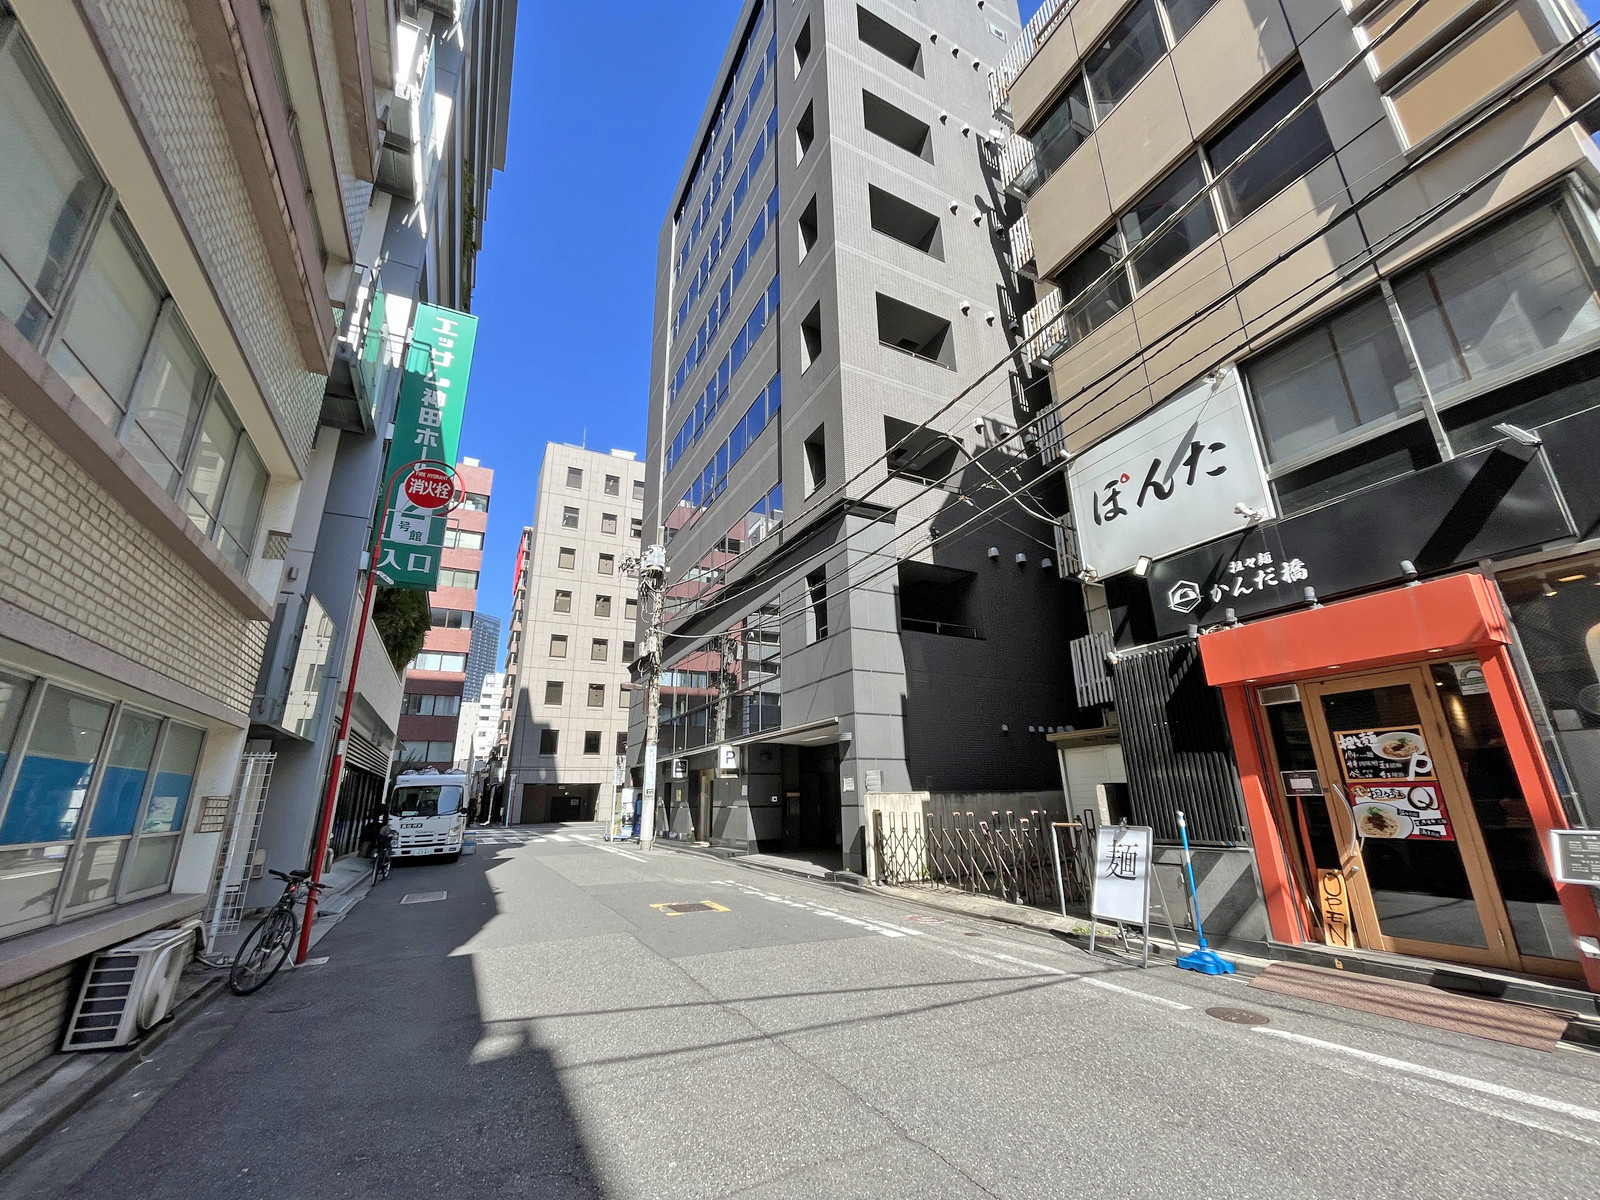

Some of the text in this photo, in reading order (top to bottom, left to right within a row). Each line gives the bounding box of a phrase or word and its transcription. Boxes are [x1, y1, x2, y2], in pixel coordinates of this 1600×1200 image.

[409, 478, 451, 499] 消火栓
[427, 473, 449, 481] HYDRANT
[1093, 441, 1228, 526] ぽんた
[377, 549, 432, 573] 入口
[1229, 551, 1273, 574] 担々麺
[1211, 558, 1309, 603] かんだ橋
[726, 750, 736, 765] P
[1408, 752, 1433, 782] P
[1407, 785, 1440, 811] Q
[1106, 840, 1138, 881] 麺
[1322, 872, 1347, 947] OPEN
